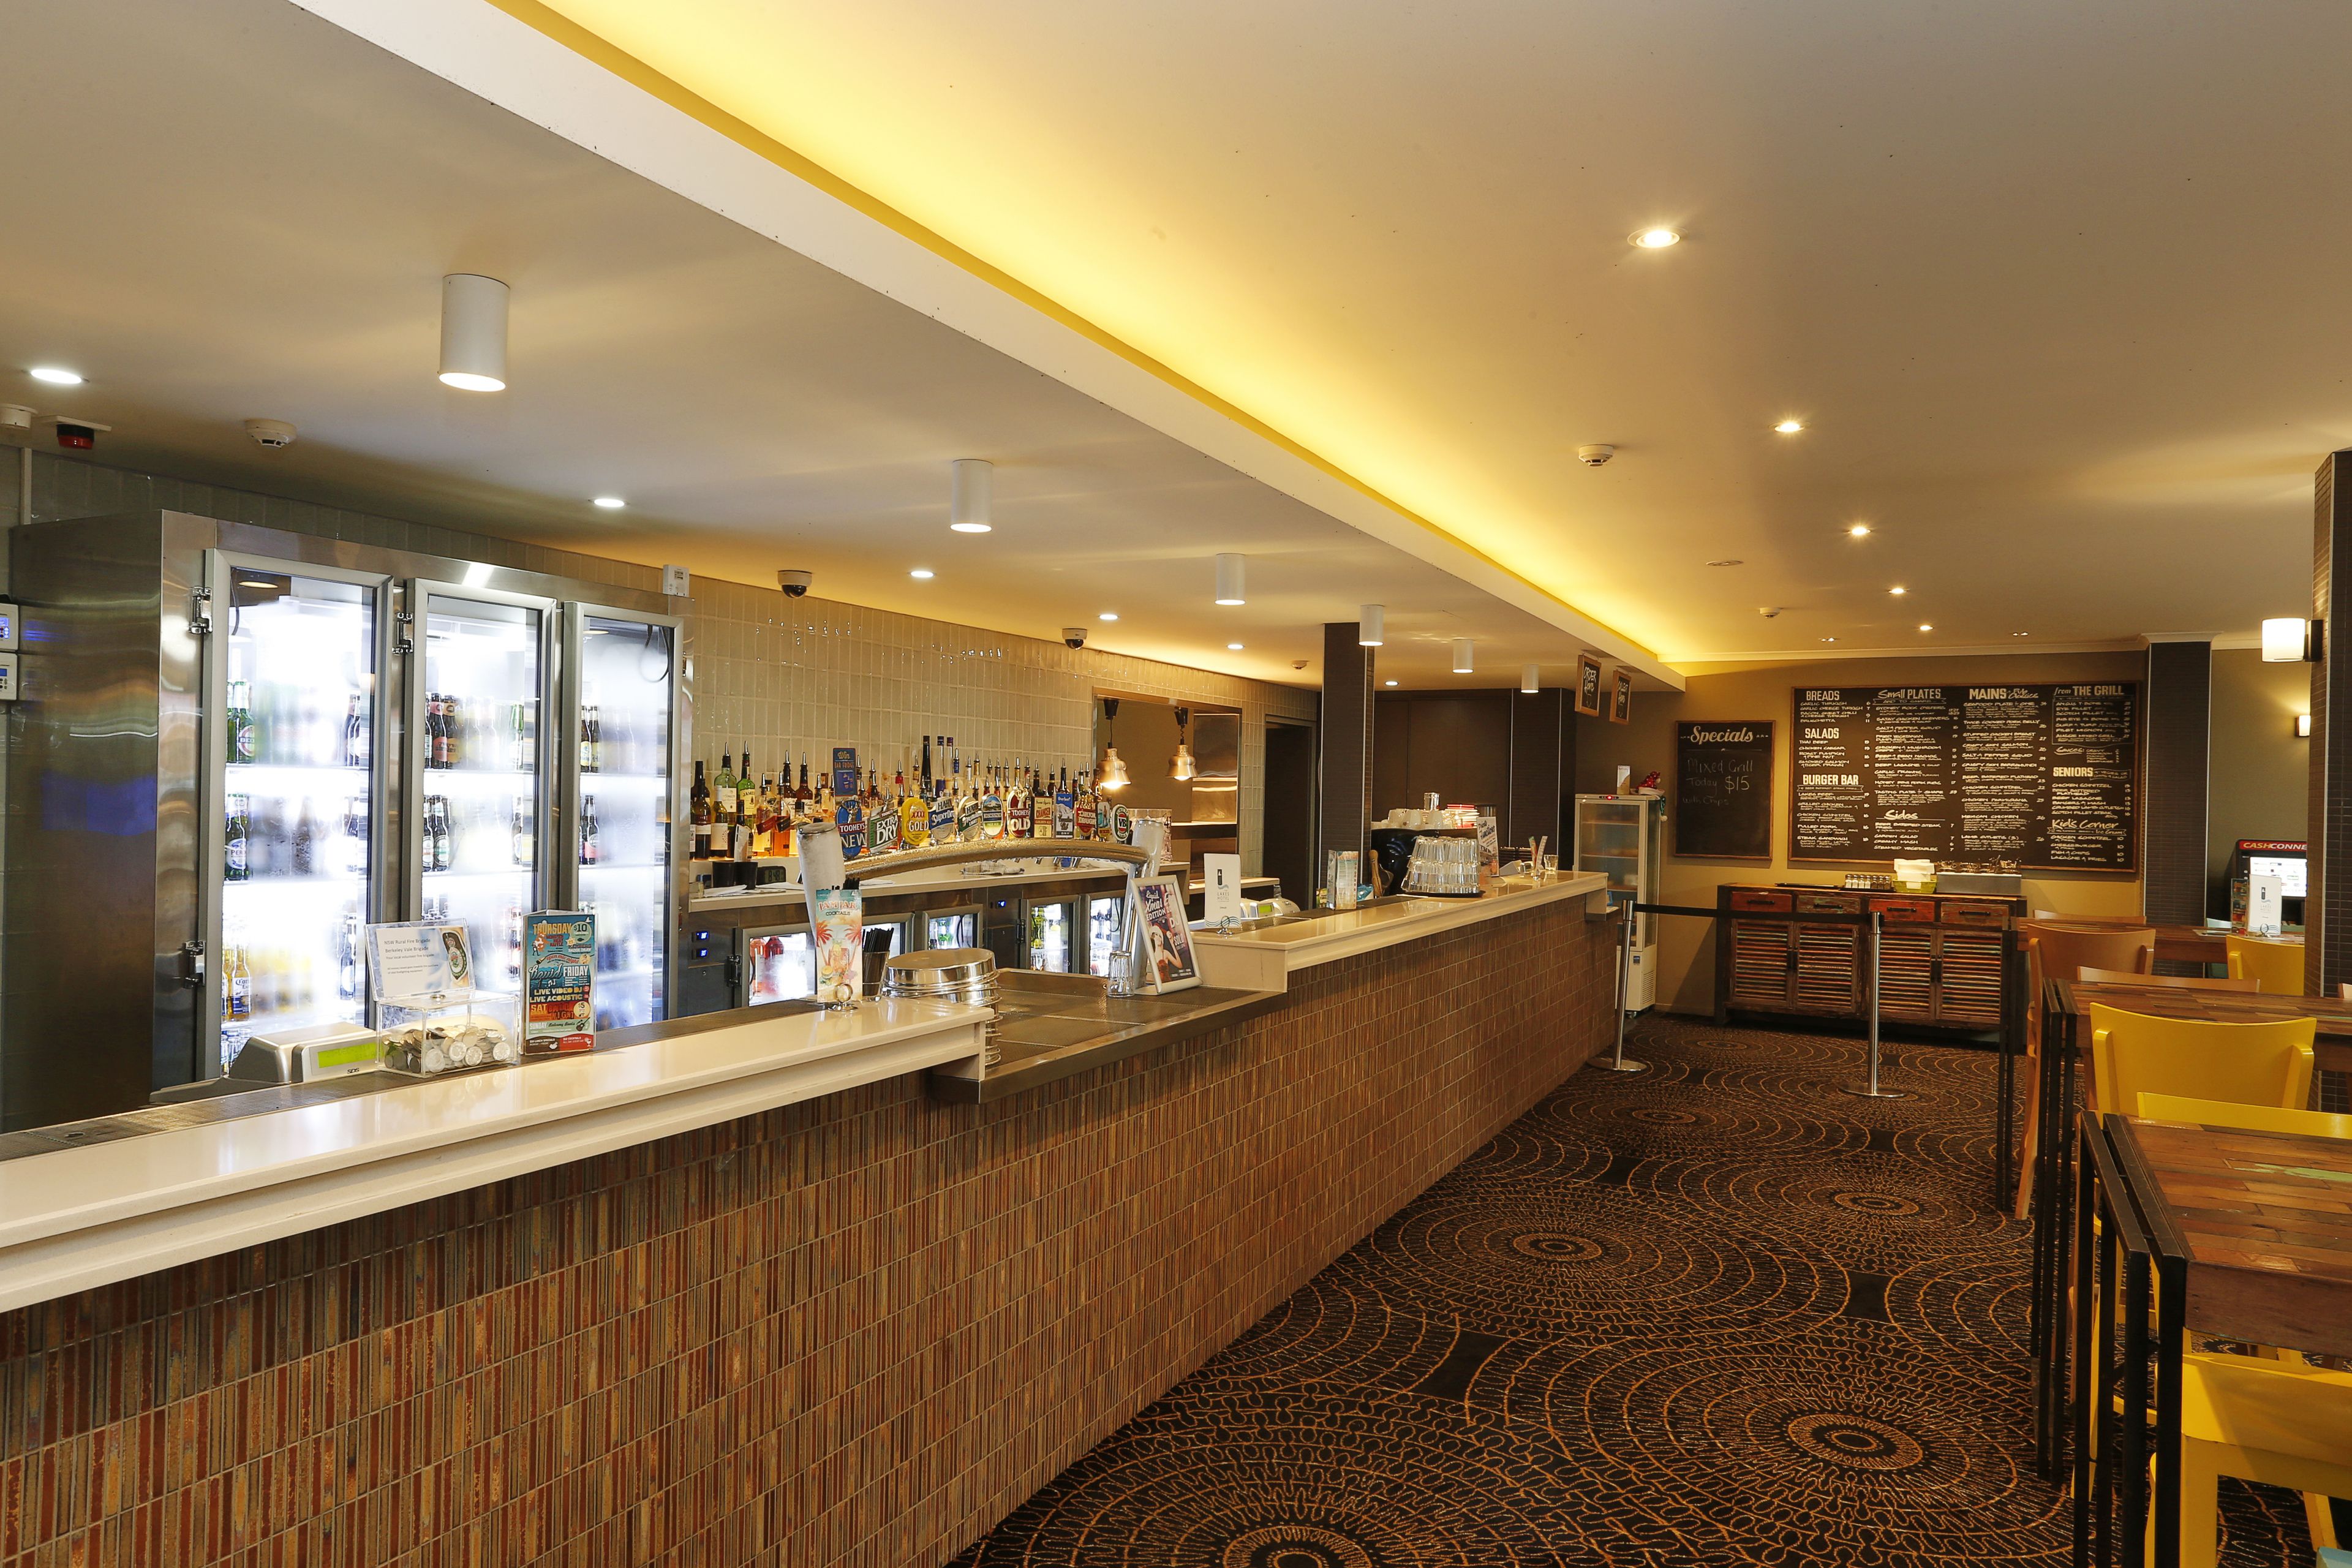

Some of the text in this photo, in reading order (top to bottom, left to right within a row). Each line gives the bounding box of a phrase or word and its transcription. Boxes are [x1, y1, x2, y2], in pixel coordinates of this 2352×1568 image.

[1806, 690, 1840, 701] BREADS
[1877, 688, 1941, 699] Small PLATES
[1969, 688, 2007, 699] MAINS
[2053, 685, 2125, 696] from THE GRILL
[1690, 725, 1753, 745] Specials
[1805, 728, 1840, 739] SALADS
[837, 750, 850, 760] Win
[1687, 758, 1753, 774] Mixed Grill
[2052, 767, 2094, 777] SENIORS
[1724, 775, 1750, 794] $15
[1803, 774, 1859, 785] BURGER BAR
[1883, 809, 1918, 820] Sides
[840, 823, 865, 833] TOOHEYS
[876, 815, 898, 831] EXTRA
[908, 821, 929, 832] GOLD
[1010, 818, 1031, 831] OLD
[1118, 818, 1127, 827] VB
[2052, 818, 2119, 829] Kid's Corner
[876, 823, 898, 845] DRY
[840, 834, 868, 848] NEW
[818, 900, 858, 911] JAM JAR
[1145, 898, 1163, 913] Xmas
[1146, 908, 1167, 921] EDITION
[532, 922, 572, 935] THURSDAY
[563, 966, 589, 977] FRIDAY
[530, 1004, 548, 1012] SAT
